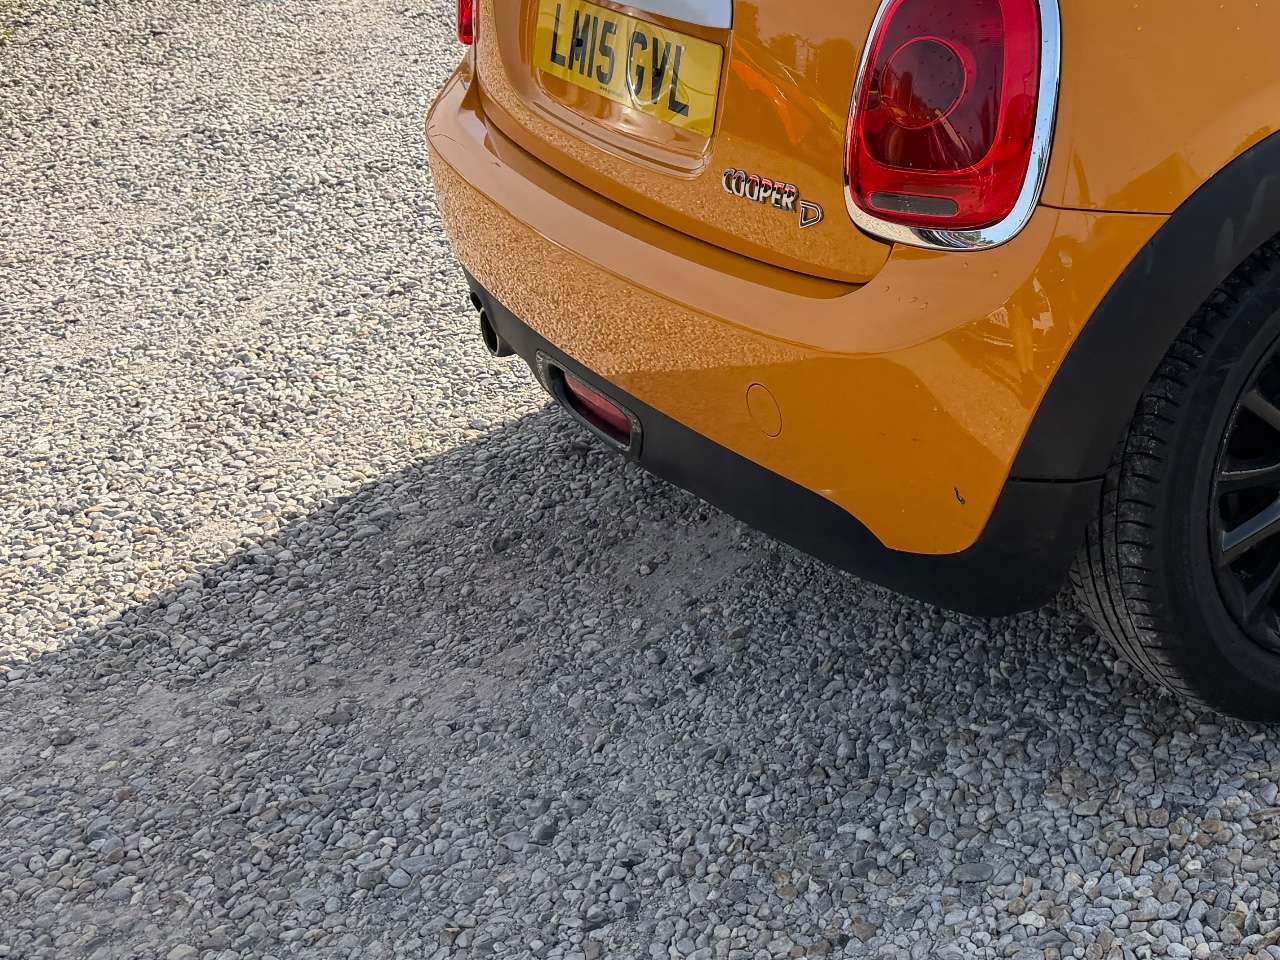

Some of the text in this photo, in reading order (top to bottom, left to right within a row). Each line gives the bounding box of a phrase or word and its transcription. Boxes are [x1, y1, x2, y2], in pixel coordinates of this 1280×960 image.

[551, 3, 689, 117] LM15 GVL
[721, 167, 824, 229] COOPER D
